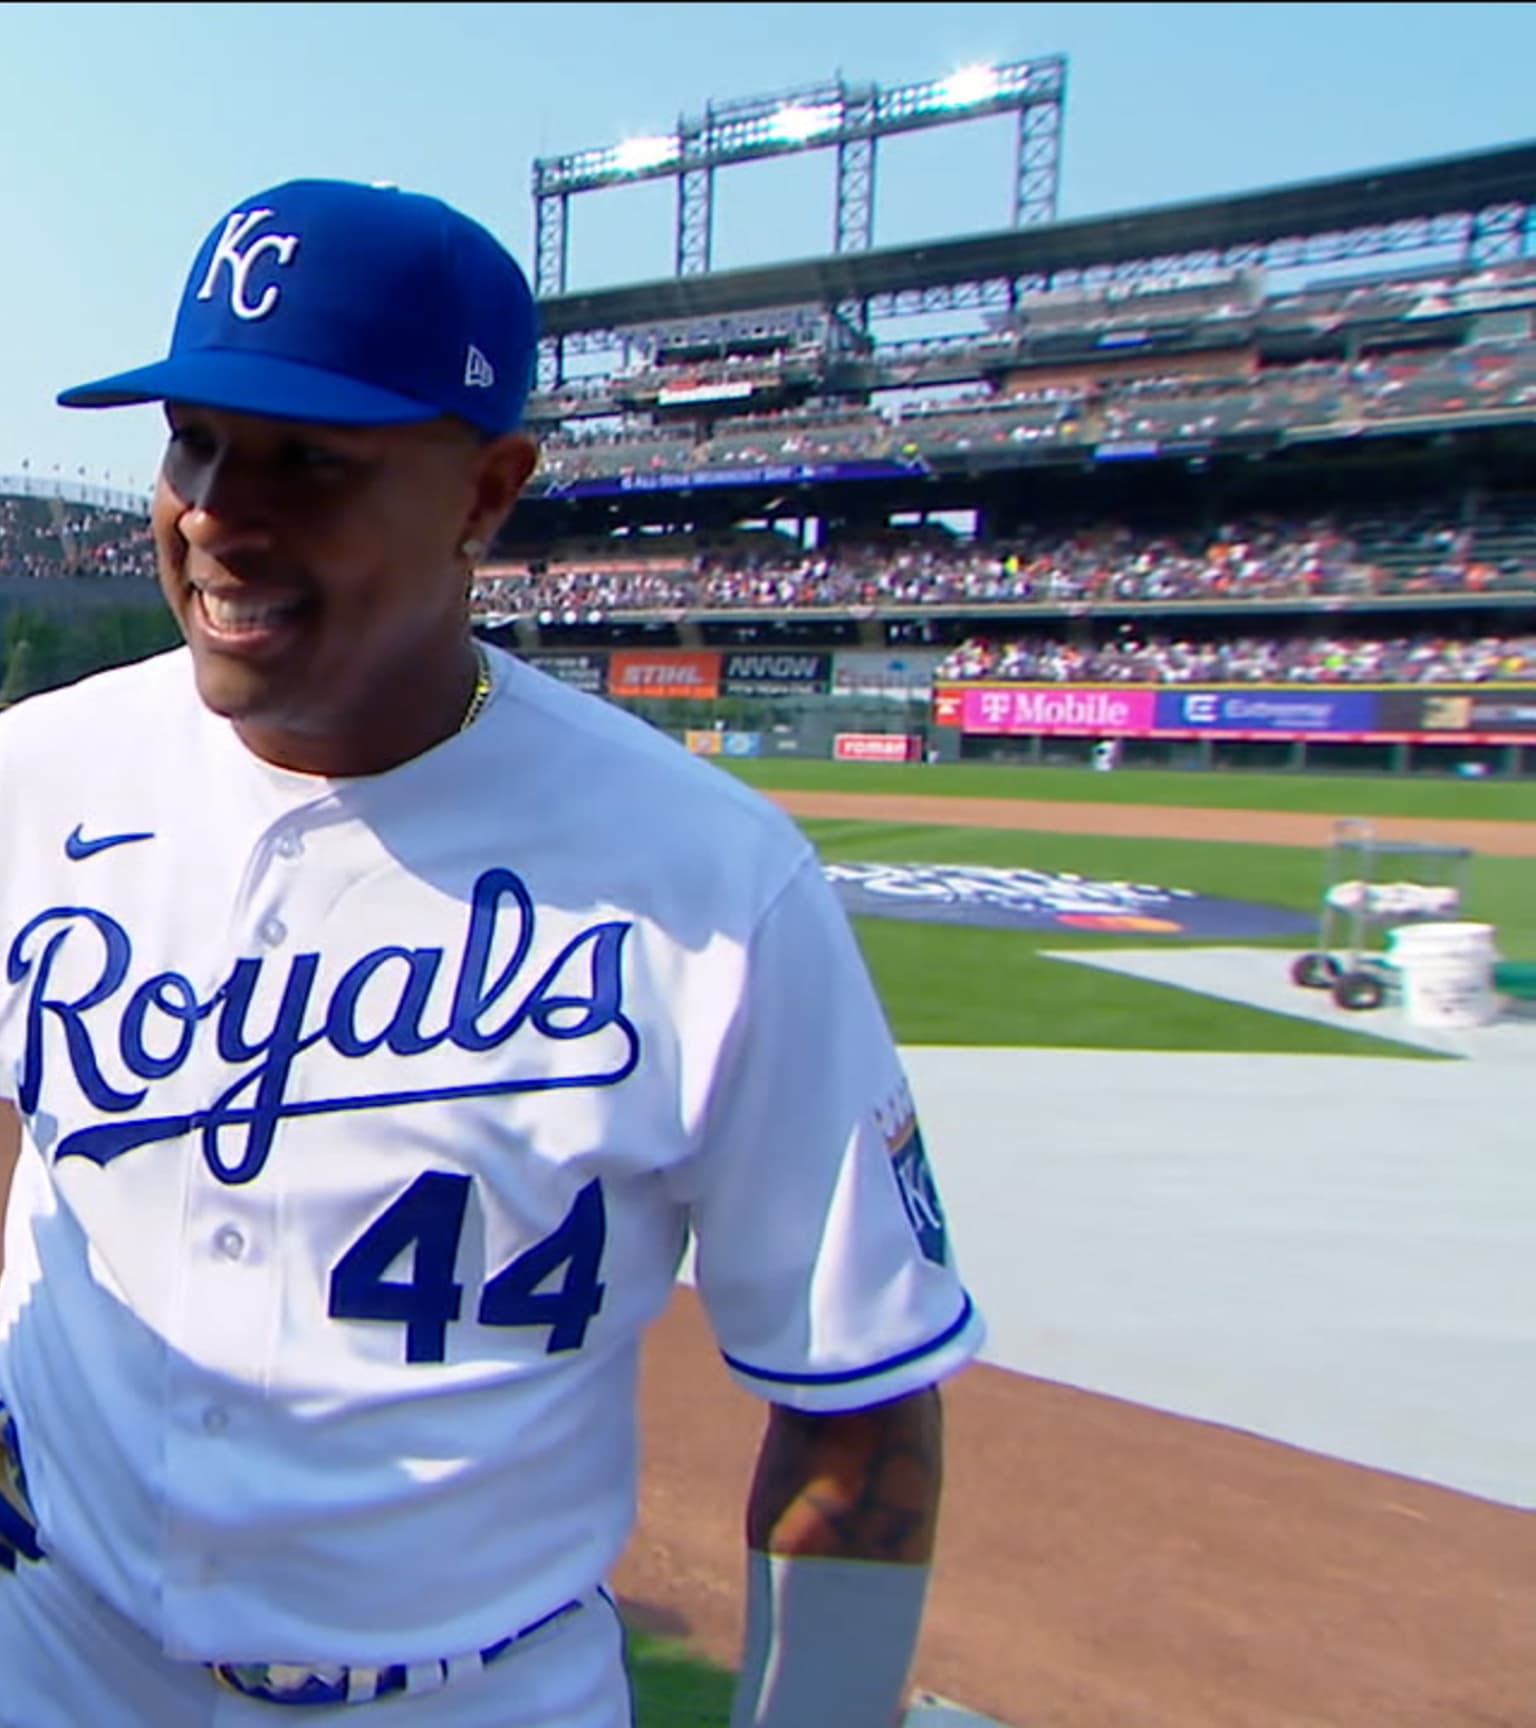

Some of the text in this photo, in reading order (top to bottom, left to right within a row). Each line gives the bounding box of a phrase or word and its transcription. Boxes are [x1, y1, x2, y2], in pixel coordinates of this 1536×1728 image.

[197, 208, 299, 320] KC
[622, 664, 703, 684] STIHL
[1017, 693, 1129, 725] Mobile
[7, 867, 640, 1185] Royals
[328, 1170, 607, 1364] 44
